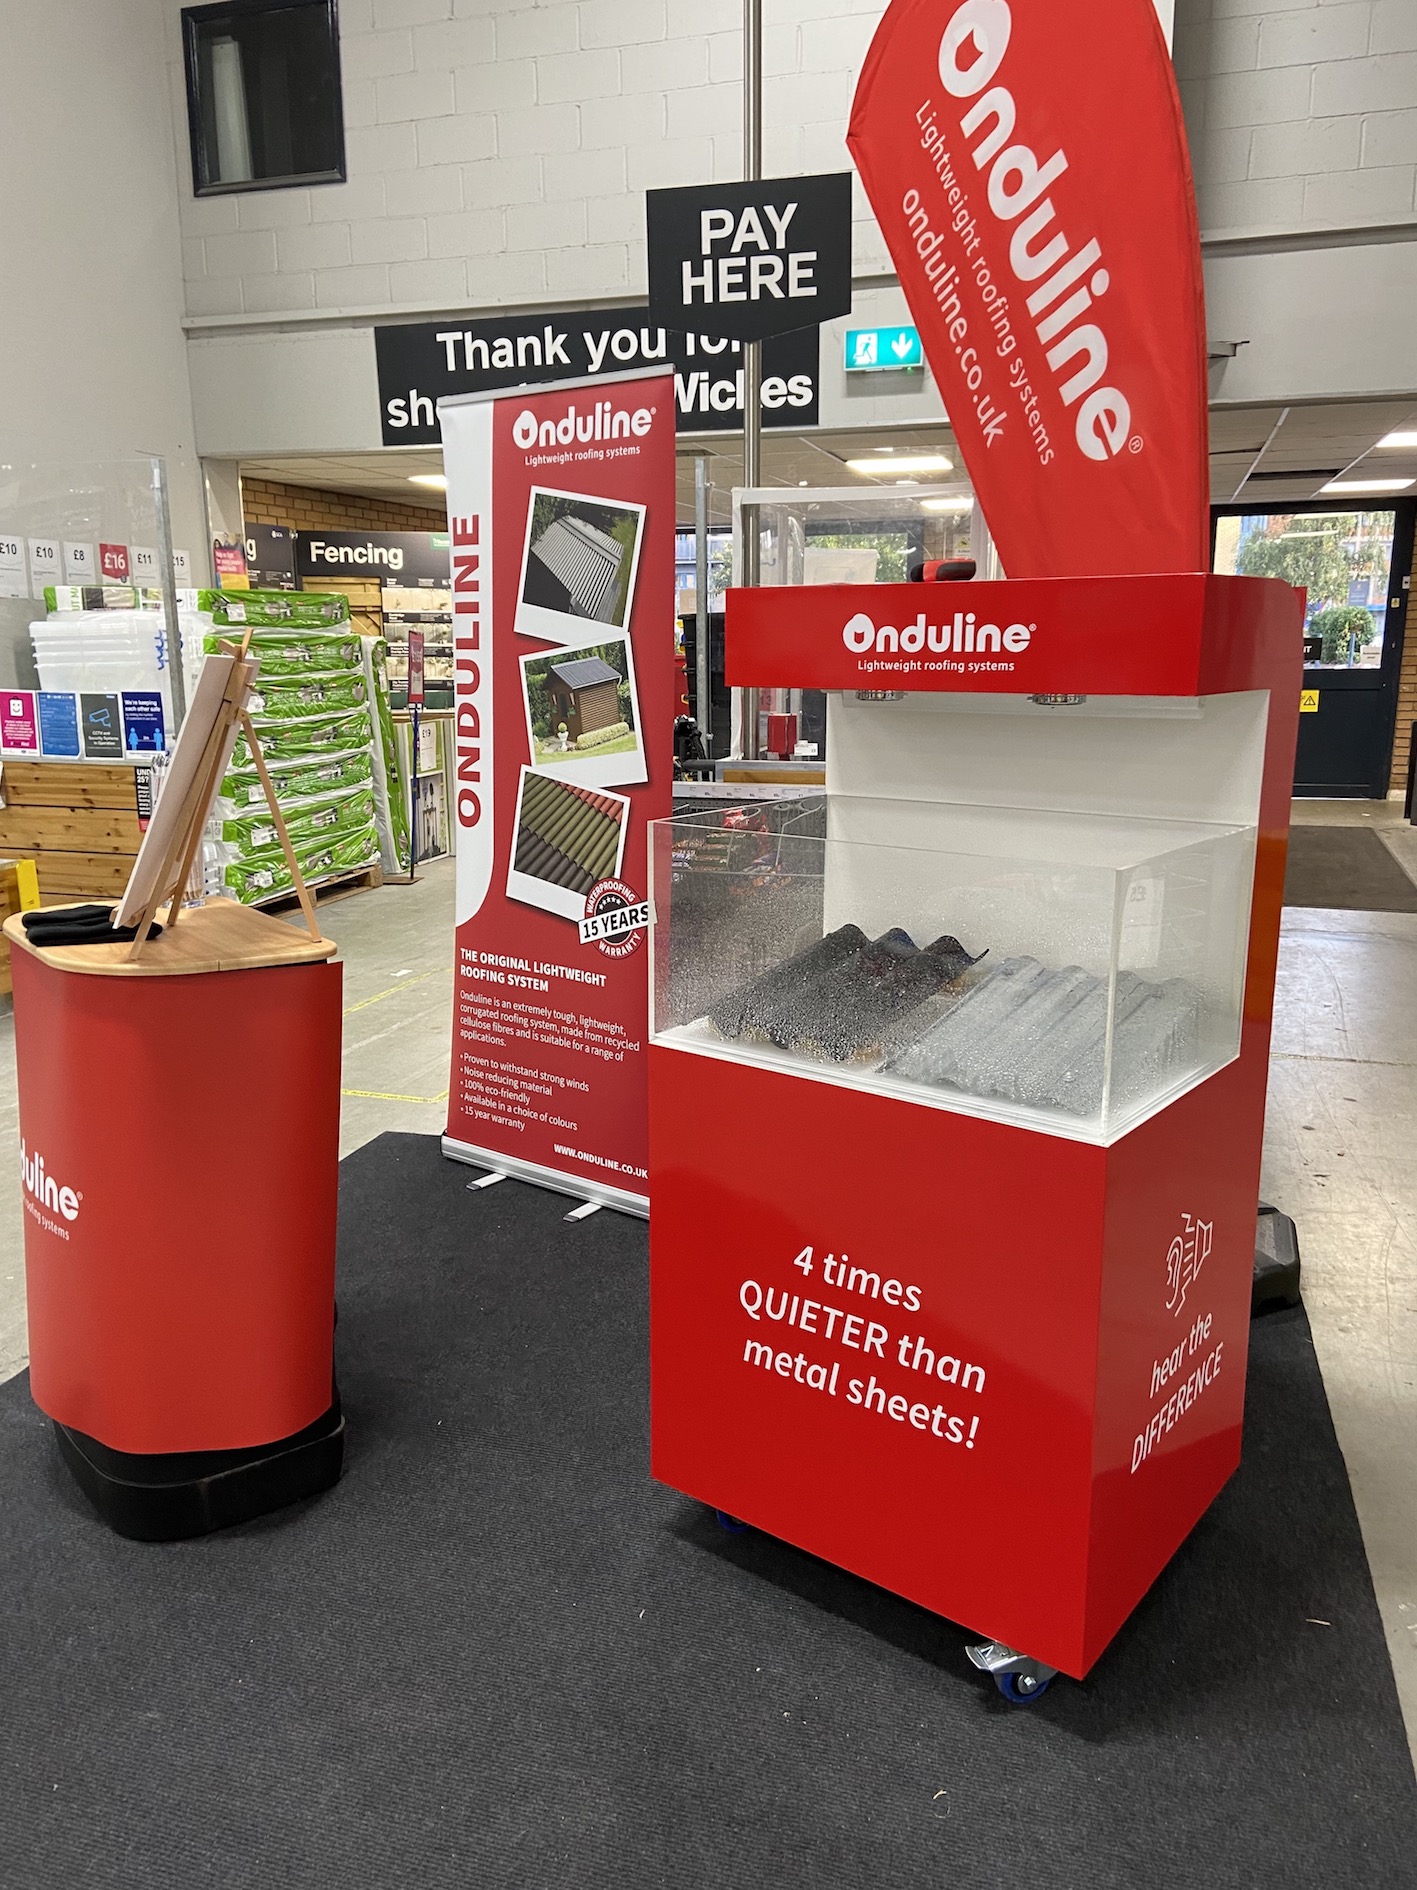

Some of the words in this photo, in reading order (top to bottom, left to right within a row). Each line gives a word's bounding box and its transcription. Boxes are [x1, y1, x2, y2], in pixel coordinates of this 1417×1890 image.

[700, 202, 798, 256] PAY
[682, 251, 818, 305] HERE
[915, 98, 980, 259] Lightweight
[971, 256, 1017, 357] roofing
[1008, 357, 1055, 467] systems
[902, 187, 1005, 450] onduline.co.uk
[436, 325, 571, 372] Thank
[583, 327, 667, 374] you
[387, 389, 439, 428] sh
[525, 452, 573, 468] Lightweight
[574, 447, 604, 462] roofing
[605, 446, 641, 460] systems
[36, 546, 54, 559] £10
[73, 550, 85, 561] £8
[104, 552, 126, 570] £16
[137, 553, 152, 565] £11
[310, 541, 403, 570] Fencing
[453, 514, 482, 829] ONDULINE
[857, 659, 922, 673] Lightweight
[924, 659, 965, 674] roofing
[967, 661, 1015, 674] systems
[586, 880, 636, 914] WATERPROOFING
[583, 920, 599, 939] 15
[601, 904, 649, 933] YEARS
[598, 931, 641, 957] WARRANTY
[460, 948, 478, 963] THE
[480, 953, 531, 972] ORIGINAL
[533, 962, 607, 987] LIGHTWEIGHT
[460, 965, 505, 984] ROOFING
[507, 974, 549, 992] SYSTEM
[460, 990, 492, 1006] Onduline
[493, 996, 501, 1007] is
[502, 1000, 512, 1010] an
[513, 1002, 552, 1018] extremely
[553, 1009, 578, 1025] tough,
[579, 1014, 627, 1037] lightweight,
[460, 1004, 499, 1020] corrugated
[500, 1012, 529, 1027] roofing
[530, 1018, 560, 1034] system,
[561, 1024, 583, 1038] made
[585, 1029, 603, 1043] from
[604, 1035, 640, 1052] recycled
[460, 1029, 507, 1047] applications.
[460, 1017, 491, 1031] cellulose
[492, 1022, 514, 1036] fibres
[515, 1027, 531, 1039] and
[532, 1030, 539, 1041] is
[540, 1033, 571, 1049] suitable
[572, 1040, 584, 1051] for
[584, 1045, 591, 1054] a
[591, 1047, 614, 1062] range
[614, 1050, 625, 1062] of
[463, 1053, 489, 1068] Proven
[490, 1059, 499, 1069] to
[500, 1060, 539, 1079] withstand
[540, 1071, 565, 1088] strong
[566, 1077, 590, 1092] winds
[463, 1066, 484, 1080] Noise
[485, 1072, 518, 1089] reducing
[520, 1080, 553, 1096] material
[464, 1079, 484, 1092] 100%
[485, 1085, 531, 1105] eco-friendly
[464, 1092, 497, 1109] Available
[498, 1100, 506, 1112] in
[506, 1105, 512, 1113] a
[513, 1104, 538, 1120] choice
[539, 1112, 549, 1123] of
[549, 1114, 578, 1131] colours
[465, 1105, 474, 1116] 15
[474, 1109, 490, 1121] year
[492, 1113, 526, 1132] warranty
[554, 1143, 649, 1179] WWW.ONDULINE.CO.UK
[42, 1215, 70, 1241] systems
[793, 1246, 815, 1276] 4
[823, 1253, 923, 1312] times
[739, 1280, 889, 1358] QUIETER
[898, 1335, 987, 1394] than
[1150, 1338, 1188, 1399] hear
[1189, 1313, 1213, 1355] the
[743, 1339, 840, 1396] metal
[846, 1376, 980, 1450] sheets!
[1131, 1342, 1224, 1475] DIFFERENCE
